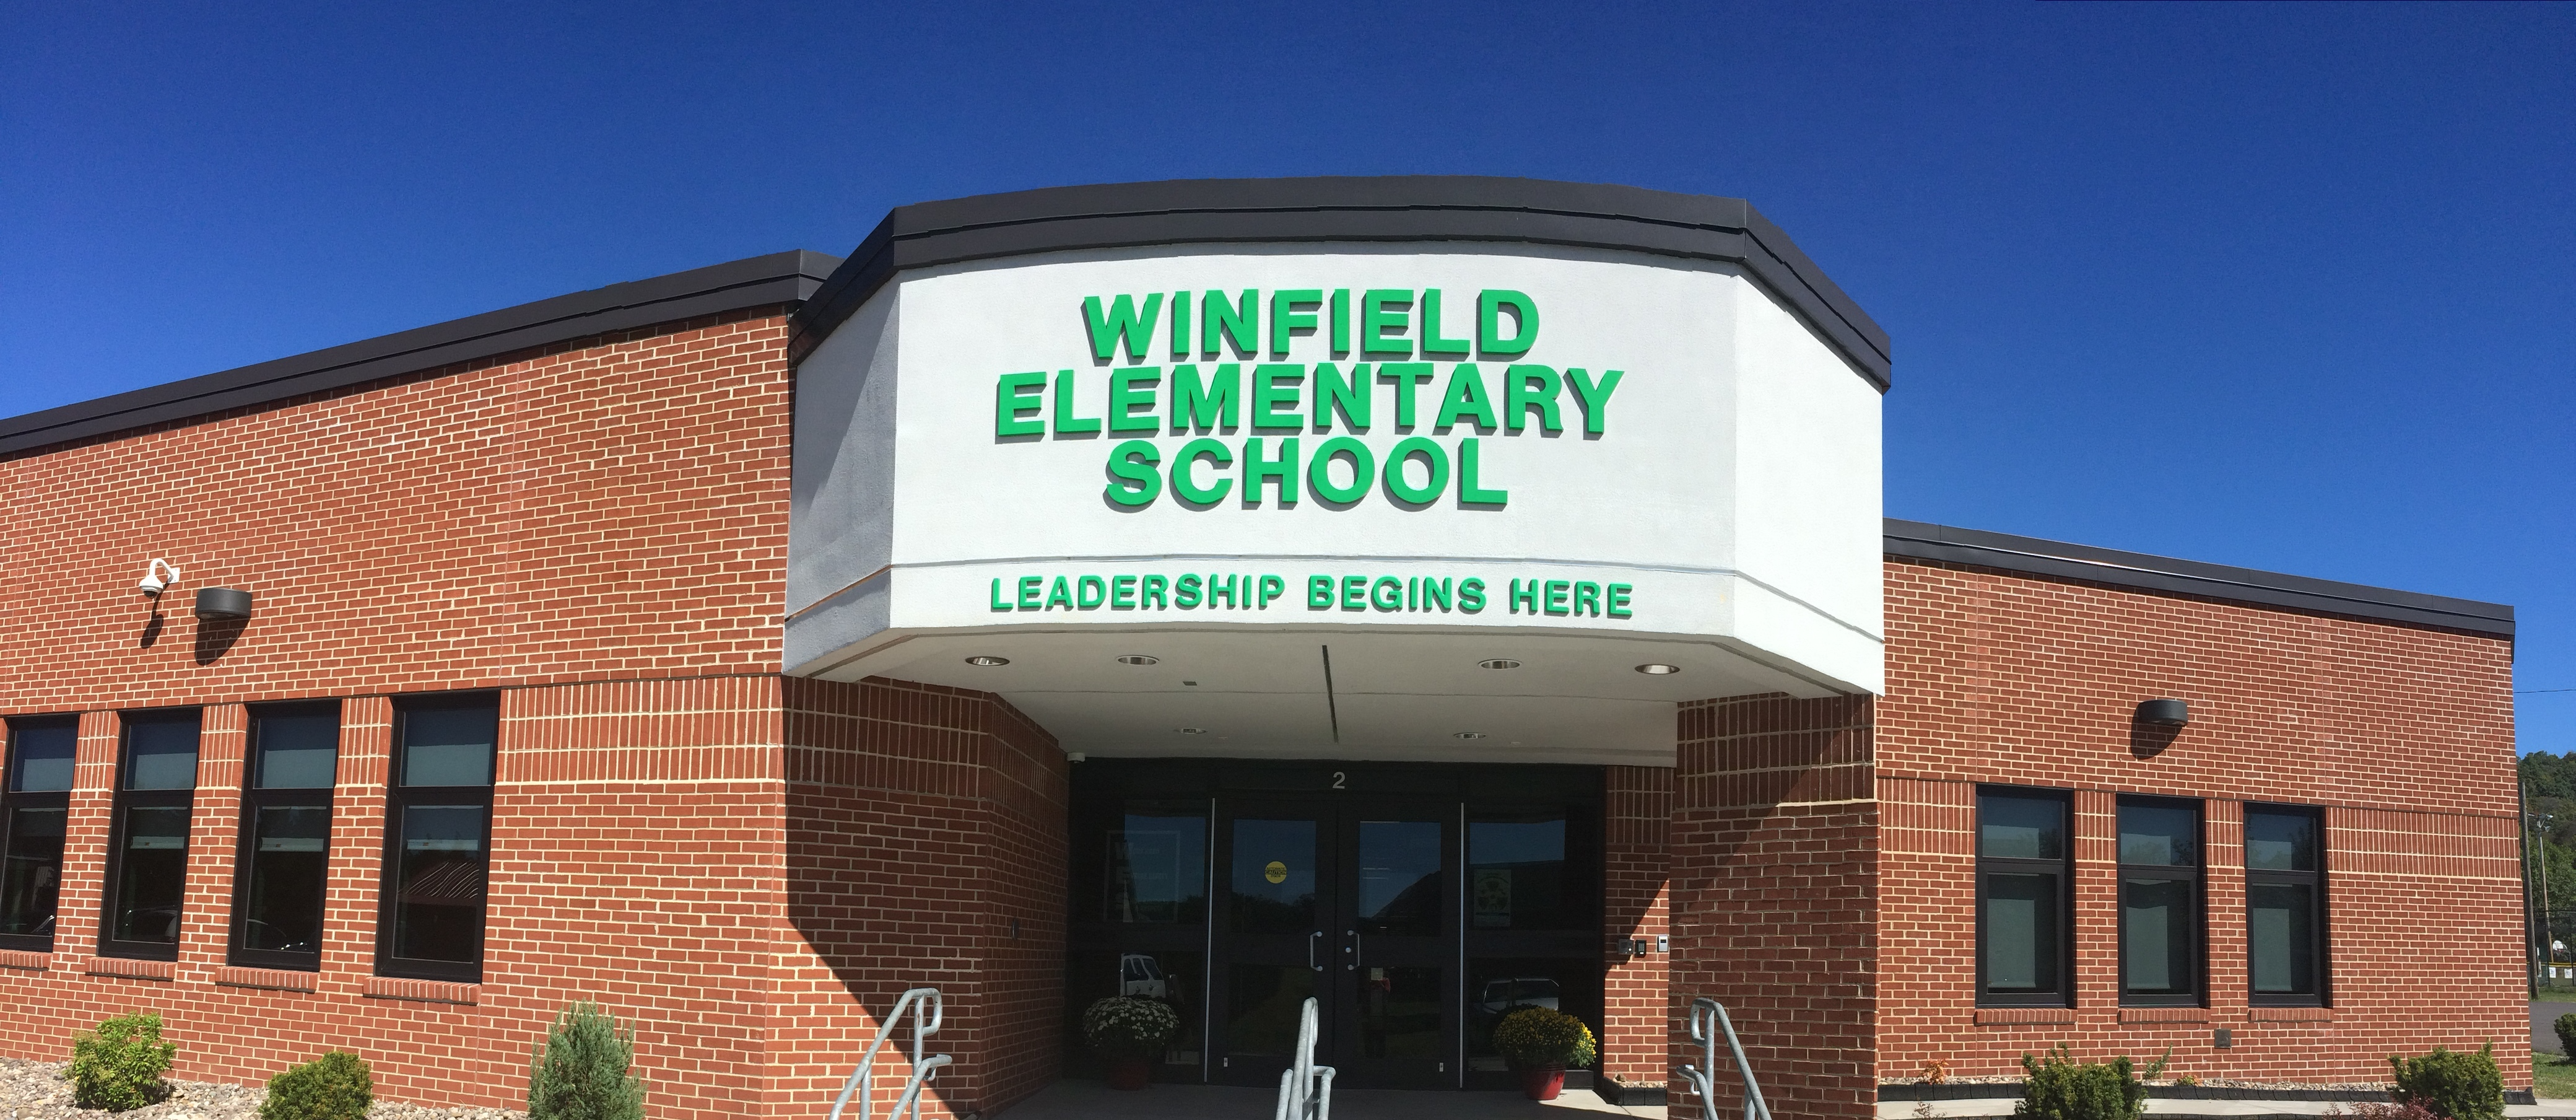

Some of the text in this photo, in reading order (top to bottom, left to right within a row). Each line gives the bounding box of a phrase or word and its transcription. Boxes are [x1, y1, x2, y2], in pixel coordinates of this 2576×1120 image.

[1082, 289, 1539, 360] WINFIELD
[996, 363, 1624, 437] ELEMENTARY
[1106, 437, 1508, 507] SCHOOL
[991, 574, 1633, 616] LEADERSHIP BEGINS HERE
[1332, 771, 1346, 789] 2
